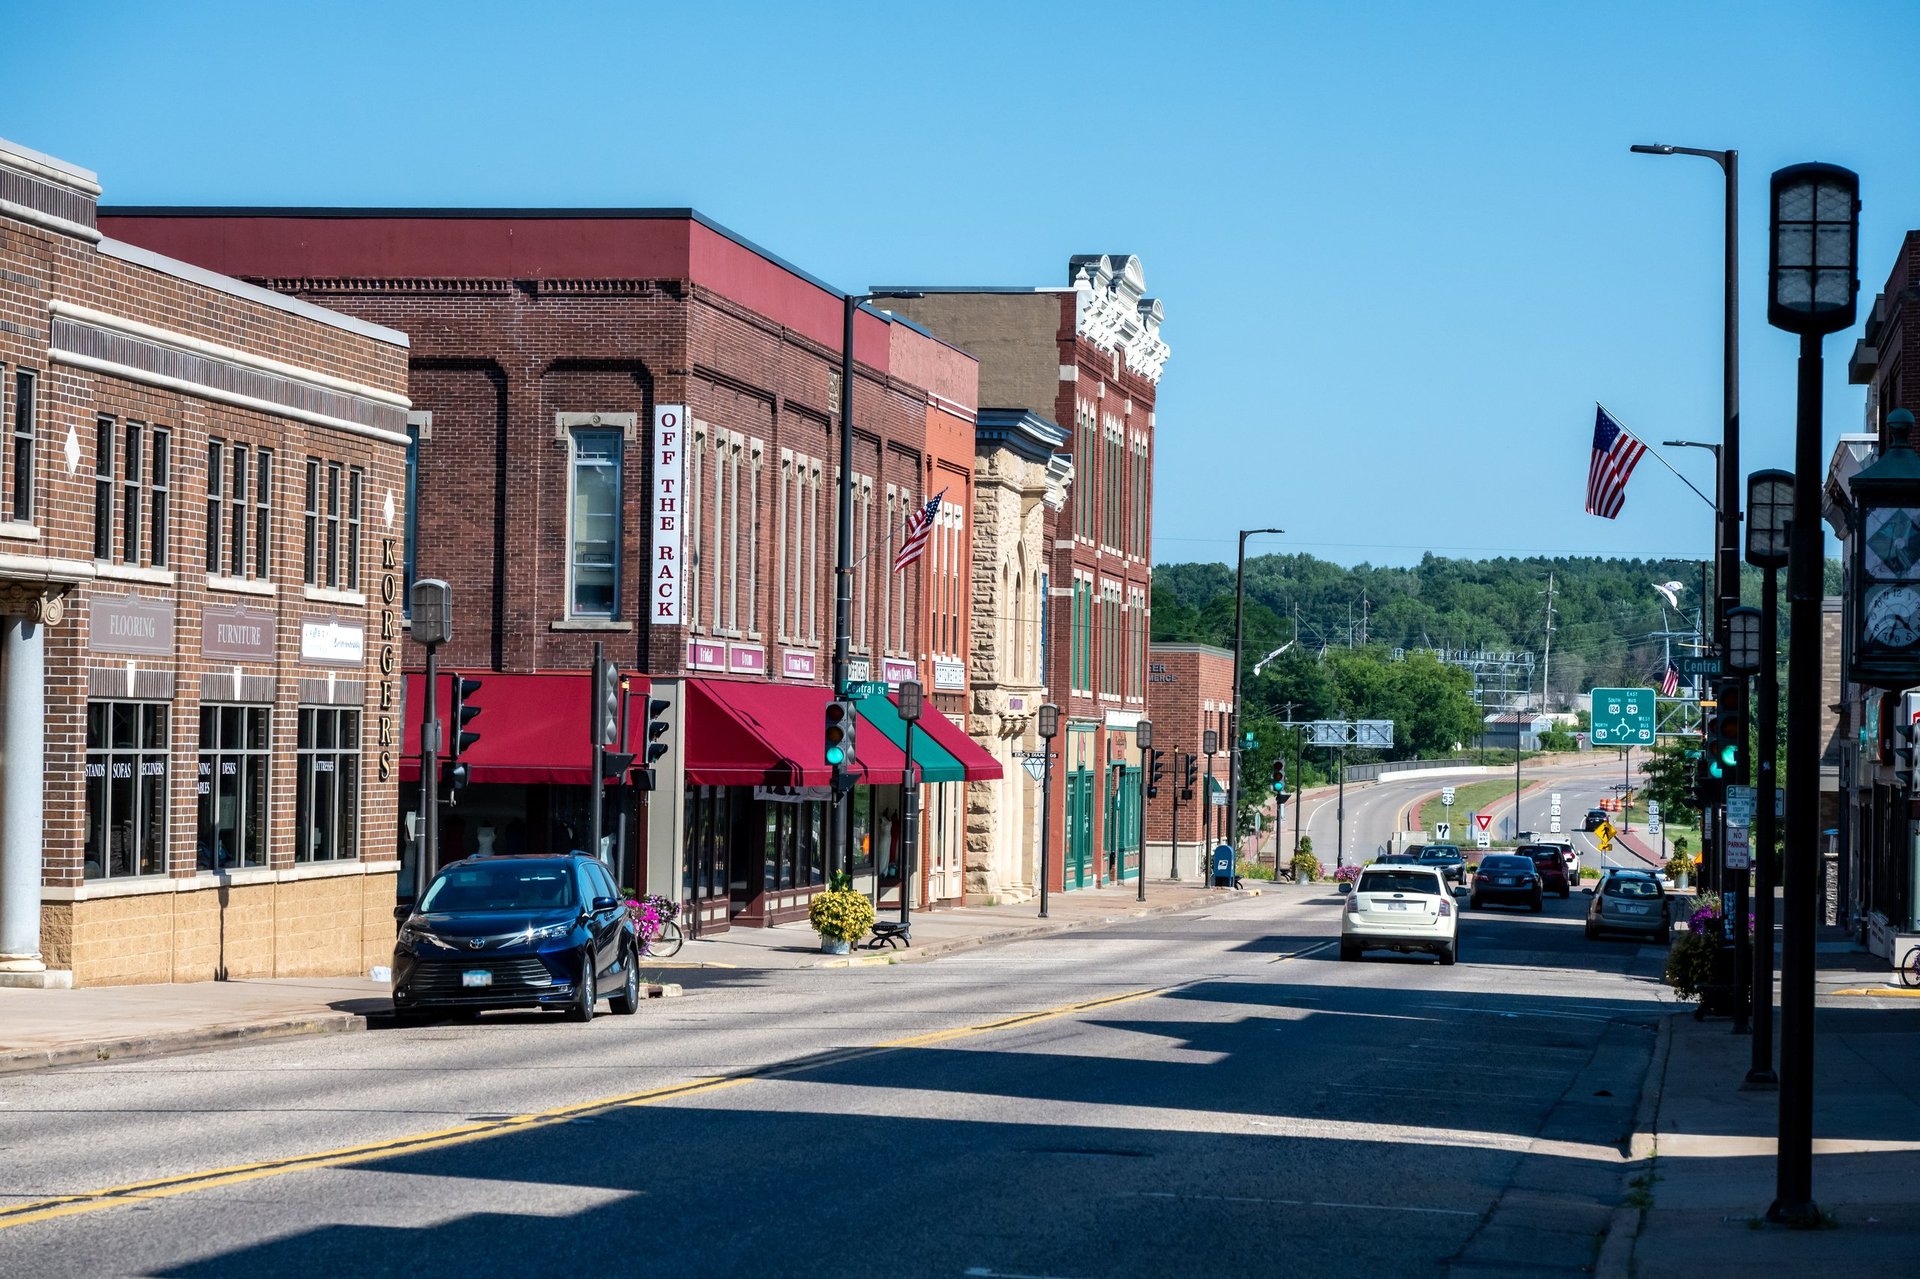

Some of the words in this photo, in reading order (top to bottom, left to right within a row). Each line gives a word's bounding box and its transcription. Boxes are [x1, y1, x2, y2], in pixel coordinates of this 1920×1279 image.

[661, 413, 677, 465] OFF
[659, 479, 676, 531] THE
[657, 546, 675, 616] RACK
[109, 614, 155, 638] FLOORING
[217, 623, 261, 646] FURNITURE
[379, 538, 396, 782] KORGERS
[1684, 659, 1721, 673] Central
[846, 681, 875, 694] Central
[877, 686, 885, 695] St
[112, 762, 132, 778] SOFAS
[222, 762, 236, 774] DESKS
[1443, 795, 1454, 803] 53
